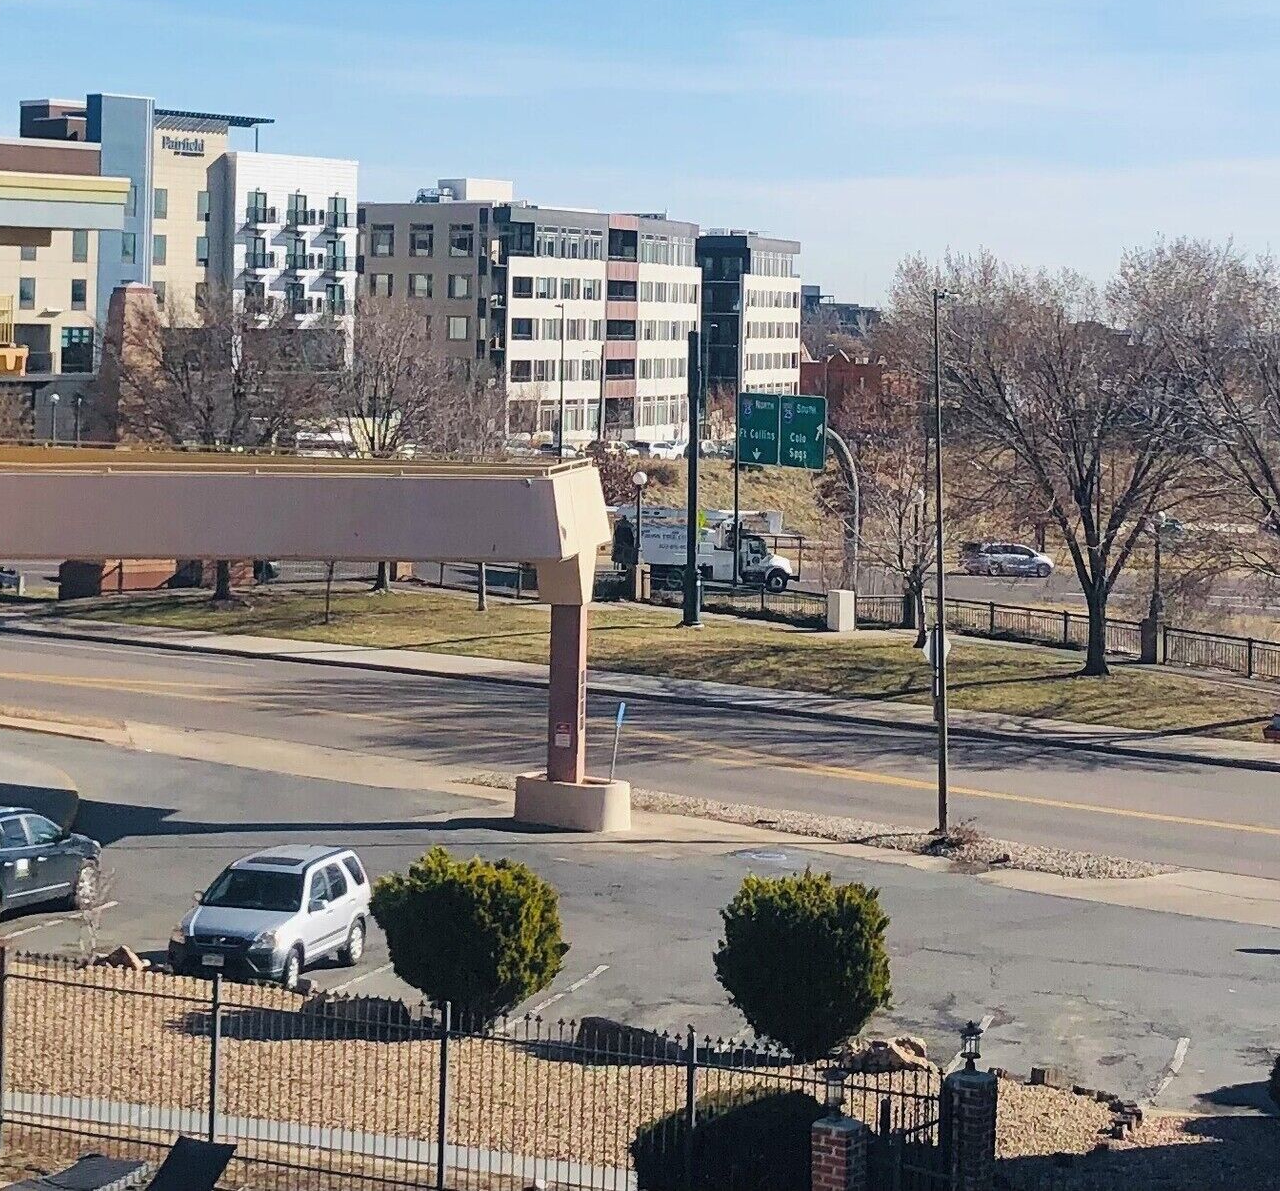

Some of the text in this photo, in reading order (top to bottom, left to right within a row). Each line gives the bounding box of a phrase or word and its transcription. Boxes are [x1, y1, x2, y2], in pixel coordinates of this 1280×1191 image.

[161, 136, 204, 152] Fairfield
[750, 429, 776, 441] Collins
[789, 432, 807, 444] Colo
[789, 448, 807, 462] Spgs
